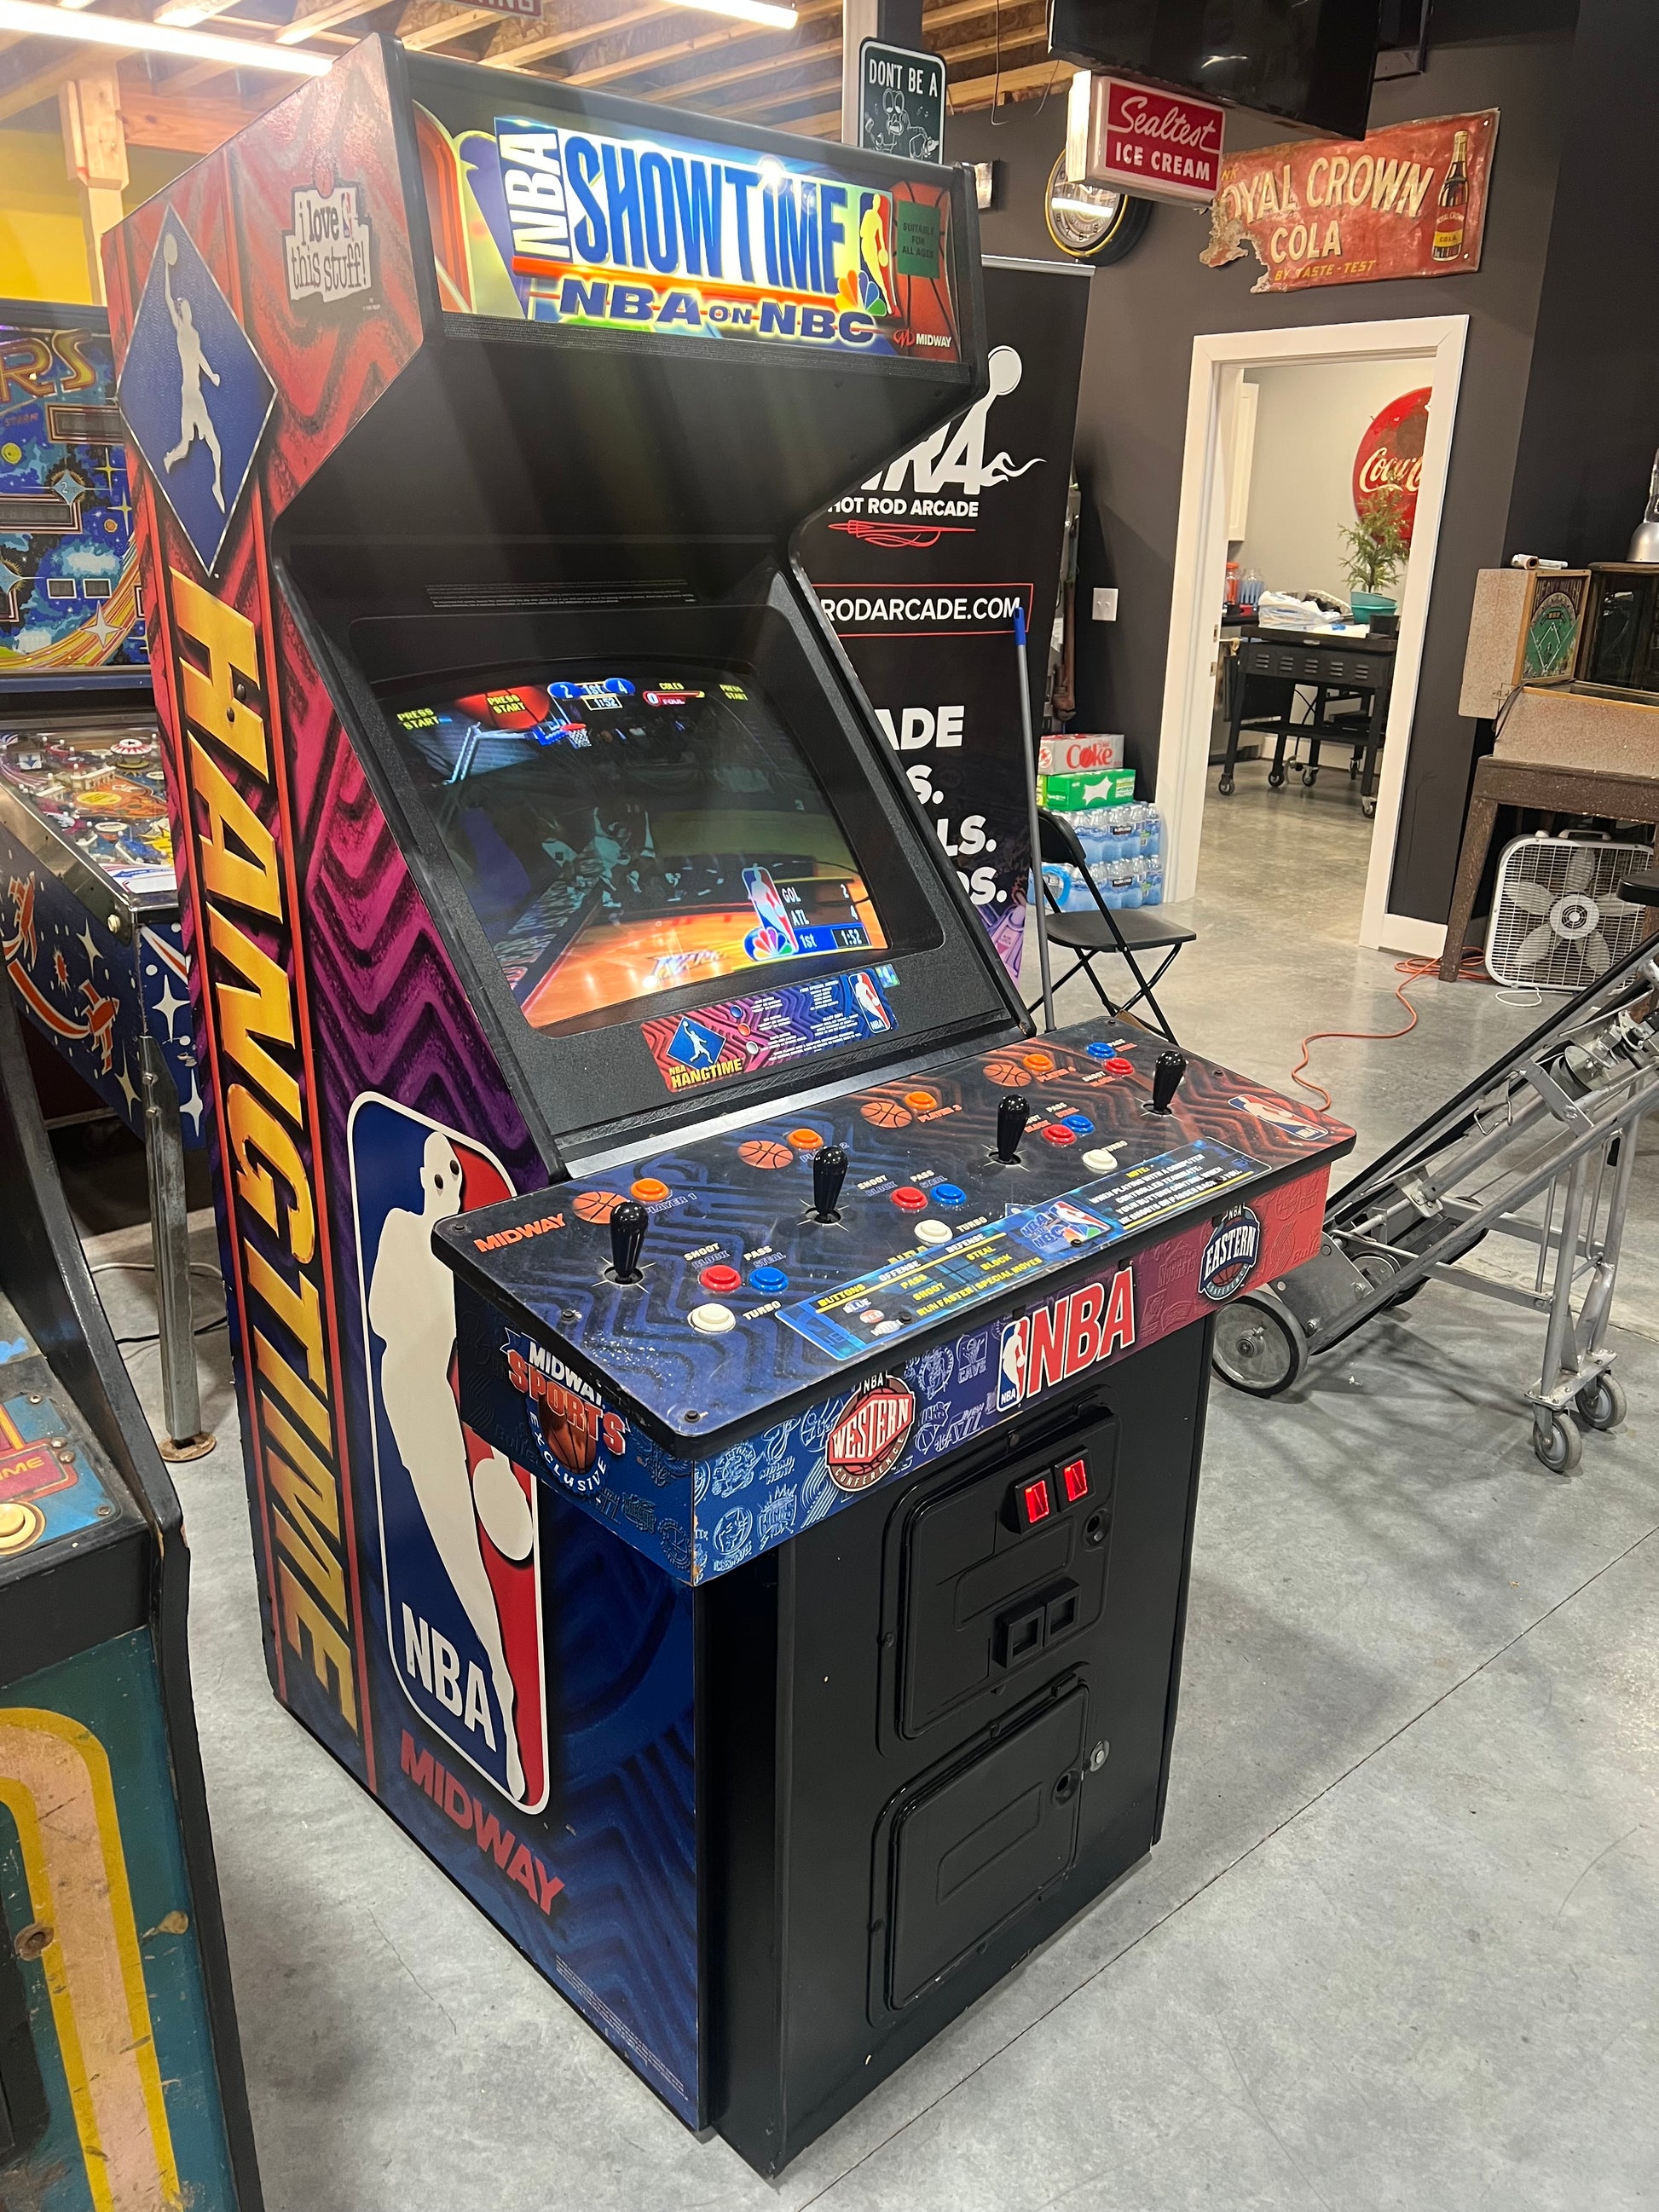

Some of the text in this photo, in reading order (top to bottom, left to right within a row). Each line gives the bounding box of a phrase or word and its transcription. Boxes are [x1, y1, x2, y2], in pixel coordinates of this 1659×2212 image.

[869, 58, 938, 97] DON'T BE A
[1108, 96, 1220, 152] Sealtest
[1115, 141, 1211, 182] ICE CREAM
[499, 132, 570, 258] NBA
[1307, 155, 1434, 218] CROWN
[298, 199, 339, 245] i love
[564, 136, 848, 296] SHOWTIME
[903, 222, 934, 236] SUITABLE
[911, 235, 925, 245] FOR
[902, 246, 914, 256] ALL
[1270, 220, 1342, 264] COLA
[291, 240, 367, 292] this stuff!
[1275, 269, 1291, 281] BY
[558, 279, 702, 326] NBA
[708, 305, 753, 326] ON
[758, 303, 876, 344] NBC
[916, 333, 952, 348] MIDWAY
[868, 498, 907, 515] ROD
[910, 499, 980, 517] ARCADE
[486, 694, 521, 707] PRESS
[560, 684, 574, 699] 2
[617, 680, 628, 695] 4
[396, 707, 435, 722] PRESS
[492, 702, 526, 714] START
[402, 716, 440, 731] START
[1066, 743, 1113, 770] Coke
[781, 884, 849, 904] GOL 2
[790, 910, 810, 926] ATL
[799, 928, 863, 949] 1st 1:52
[870, 1019, 884, 1031] NBA
[668, 1065, 686, 1076] NBA
[670, 1059, 743, 1089] HANGTIME
[169, 565, 358, 1737] HANGTIME
[857, 1175, 888, 1190] SHOOT
[910, 1170, 935, 1182] PASS
[1089, 1191, 1114, 1204] WHEN
[1111, 1178, 1145, 1195] PLAYING
[1142, 1170, 1165, 1181] WITH
[1166, 1153, 1205, 1172] COMPUTER
[1195, 1181, 1217, 1191] BACK
[1115, 1201, 1139, 1215] YOUR
[1169, 1175, 1205, 1192] CONTROL
[1200, 1166, 1224, 1178] WHEN
[1115, 1181, 1165, 1204] CONTROLLED
[956, 1216, 988, 1233] TURBO
[1228, 1204, 1242, 1221] NBA
[473, 1212, 566, 1253] MIDWAY
[1020, 1213, 1050, 1238] NBA
[1032, 1224, 1065, 1249] NBC
[683, 1242, 720, 1262] SHOOT
[691, 1250, 731, 1269] BLOCK
[743, 1245, 774, 1262] PASS
[752, 1251, 787, 1269] STEAL
[1204, 1225, 1257, 1281] EASTERN
[818, 1233, 987, 1307] BUTTONS OFFENSE DEFENSE
[843, 1246, 996, 1314] BLUE PASS STEAL
[912, 1282, 945, 1301] SHOOT
[980, 1254, 1013, 1271] BLOCK
[916, 1302, 939, 1317] RUN
[938, 1286, 974, 1308] FASTER
[974, 1270, 1014, 1290] SPECIAL
[1011, 1256, 1043, 1274] MOVES
[742, 1300, 782, 1321] TURBO
[1026, 1266, 1136, 1398] NBA
[863, 1372, 884, 1394] NBA
[507, 1349, 627, 1456] SPORTS
[1000, 1388, 1016, 1405] NBA
[832, 1397, 910, 1460] WESTERN
[529, 1410, 607, 1492] EXCLUSIVE
[835, 1436, 904, 1487] CONFERENCE
[402, 1603, 496, 1753] NBA
[401, 1729, 564, 1916] MIDWAY
